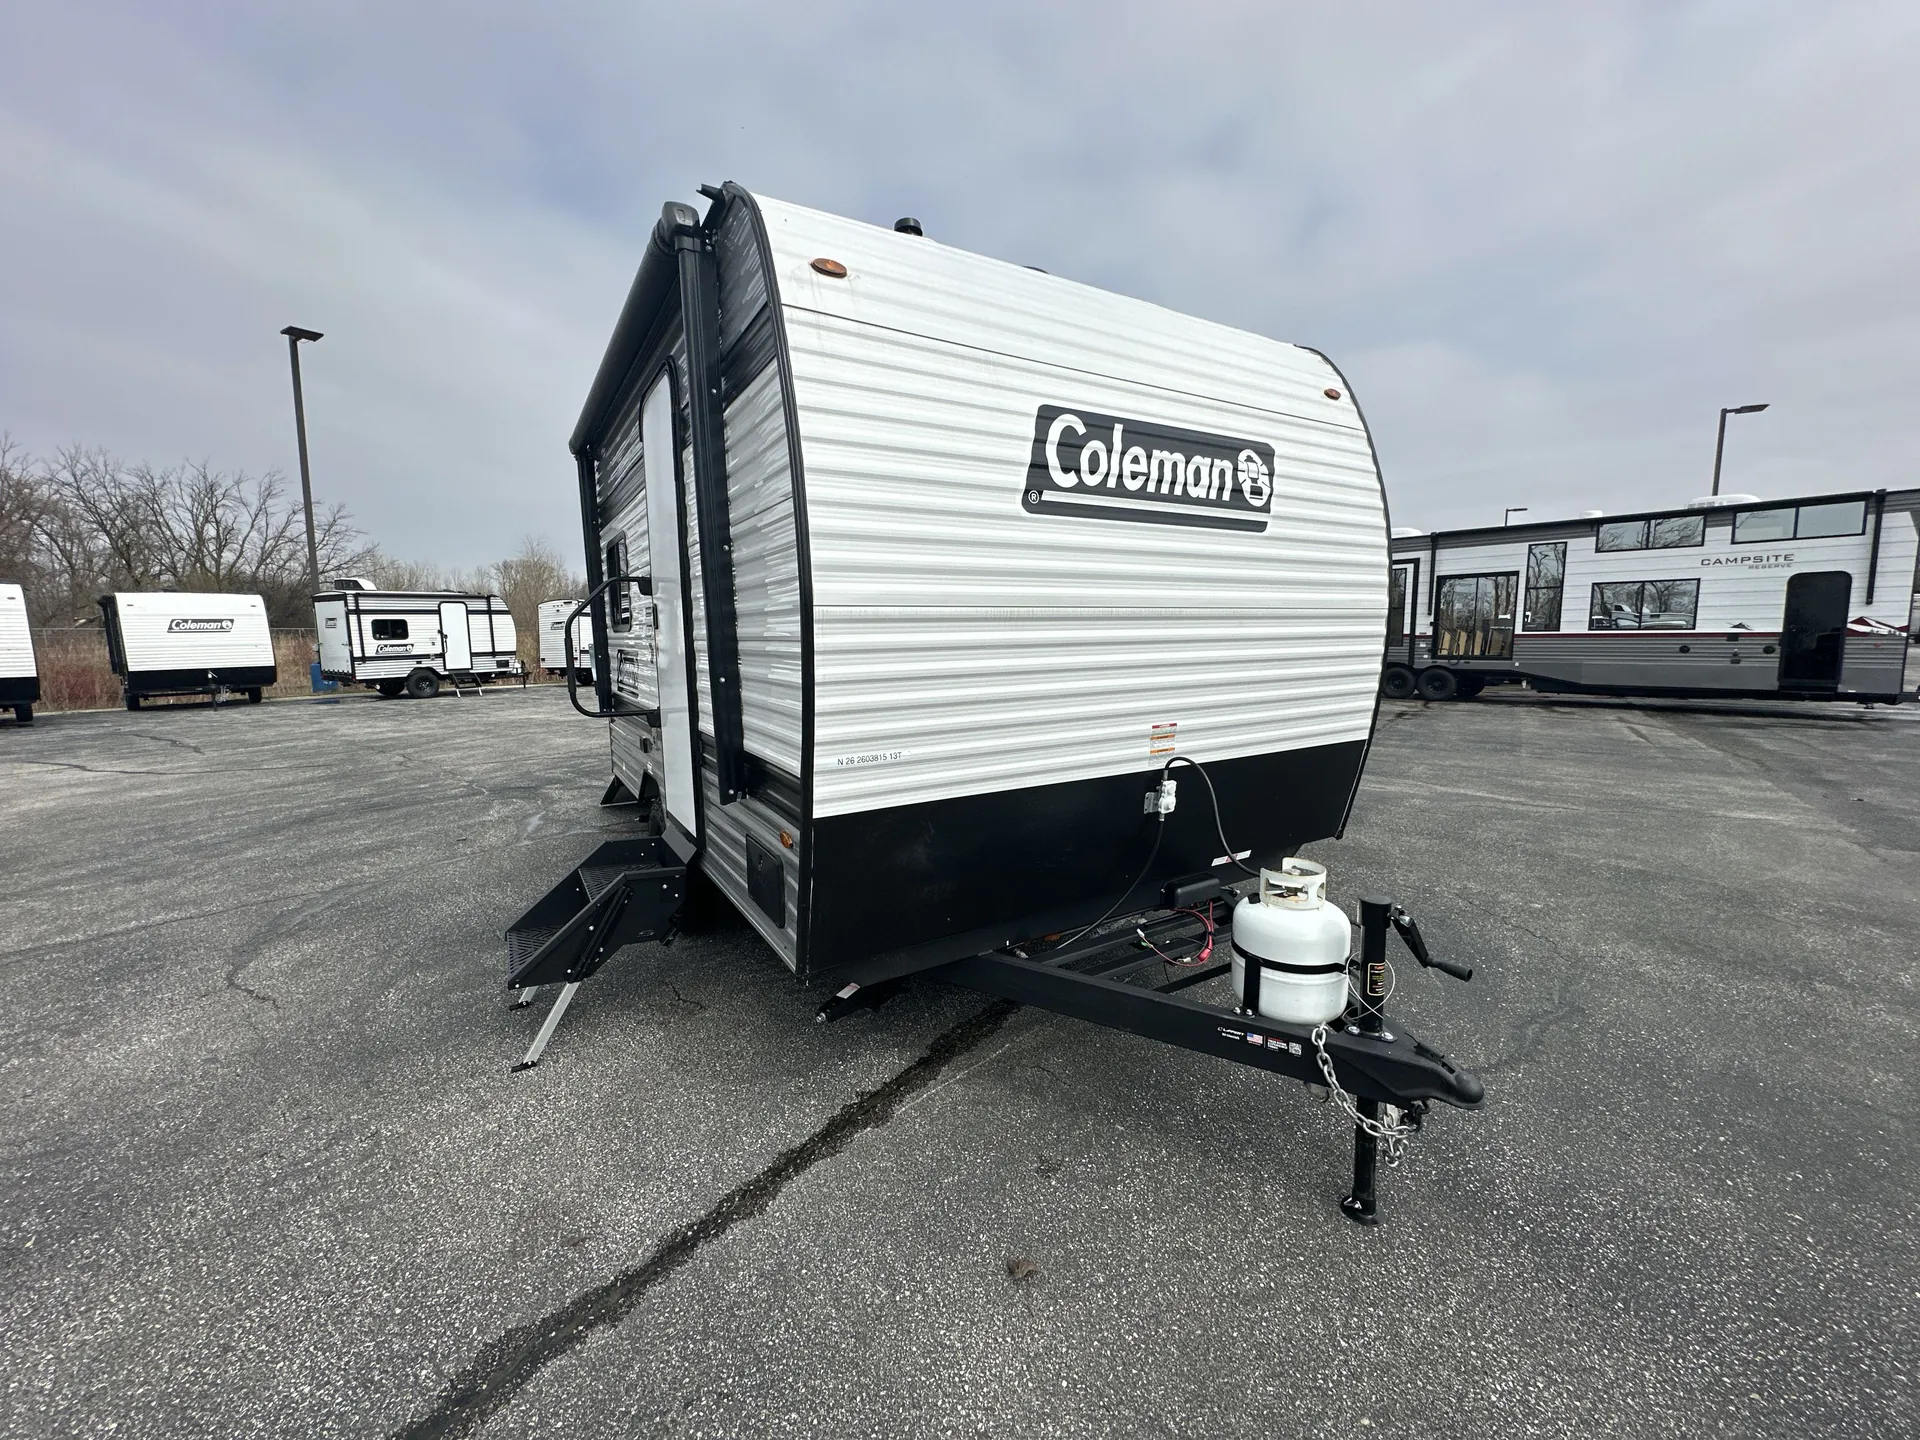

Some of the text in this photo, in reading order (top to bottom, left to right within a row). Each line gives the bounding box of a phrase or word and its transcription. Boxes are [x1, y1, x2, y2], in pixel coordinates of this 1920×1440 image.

[1045, 413, 1234, 502] Coleman
[1700, 553, 1795, 566] CAMPSITE
[171, 619, 222, 630] Coleman
[837, 758, 844, 766] N
[845, 756, 856, 765] 26
[889, 751, 902, 760] 13T
